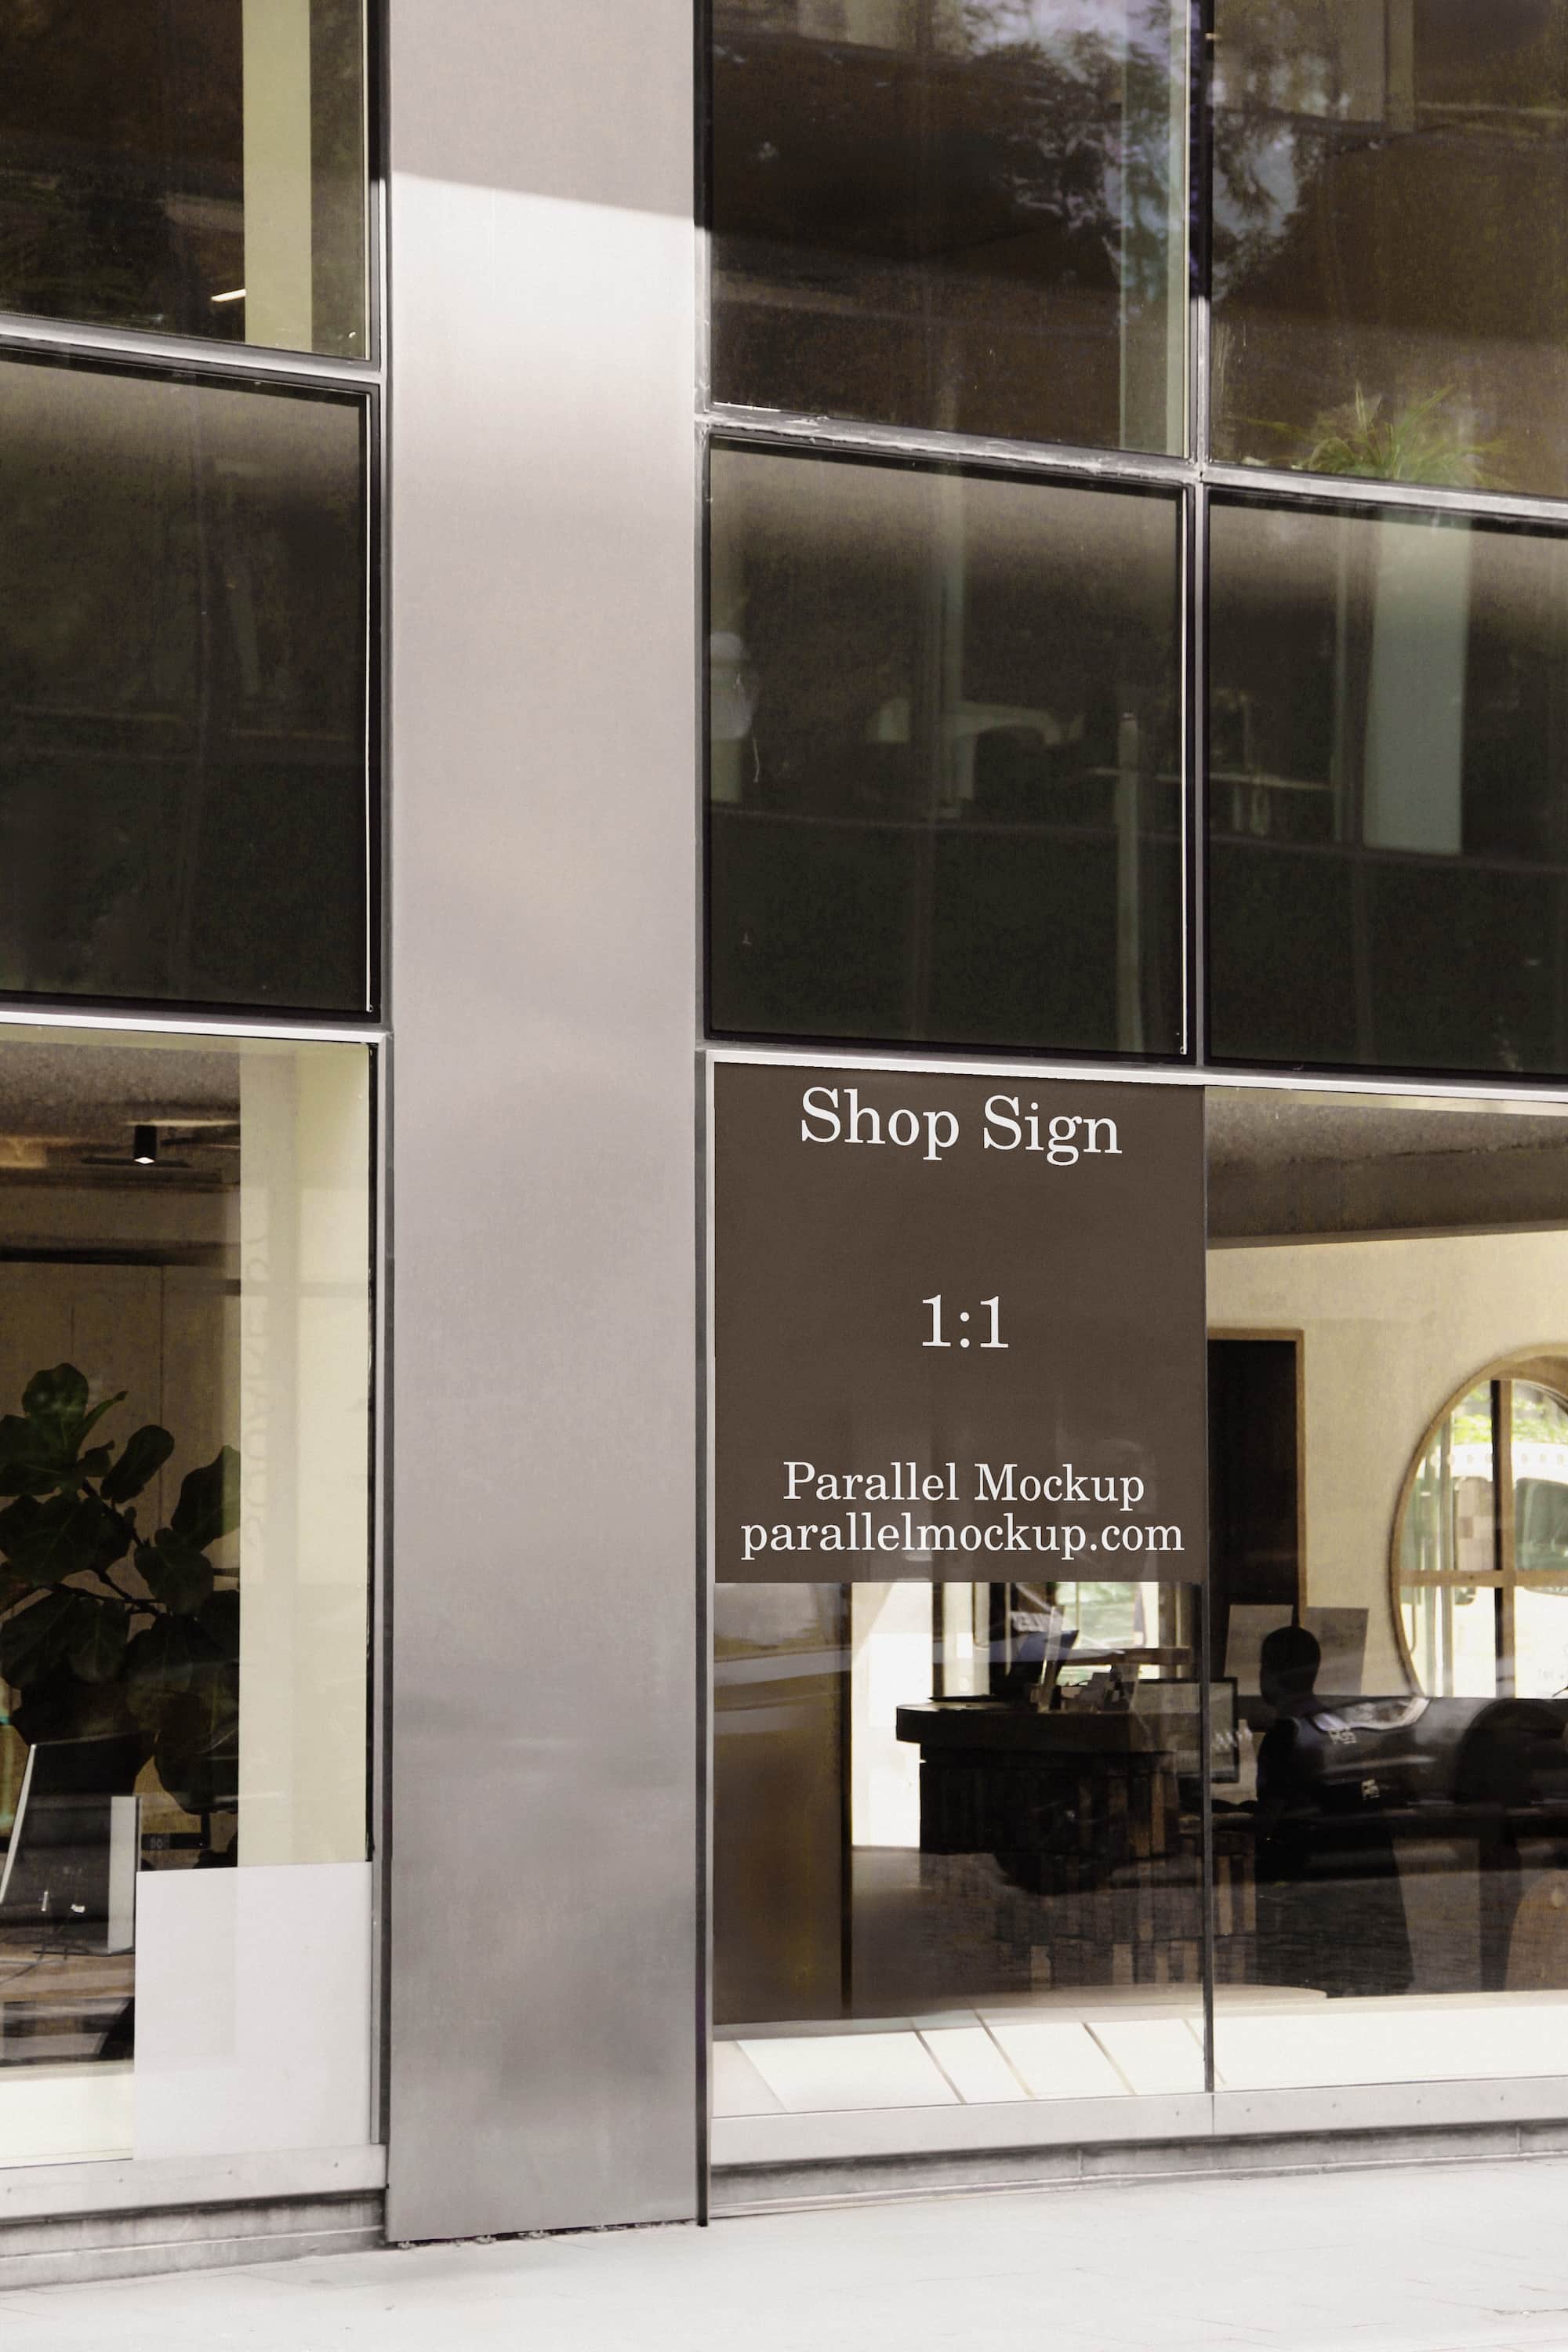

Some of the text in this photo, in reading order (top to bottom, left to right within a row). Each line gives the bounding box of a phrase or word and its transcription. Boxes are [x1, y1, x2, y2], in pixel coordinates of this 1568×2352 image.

[800, 1086, 1123, 1166] Shop Sign
[921, 1294, 1010, 1348] 1:1
[783, 1461, 1145, 1512] Parallel Mockup
[740, 1512, 1185, 1562] parallelmockup.com
